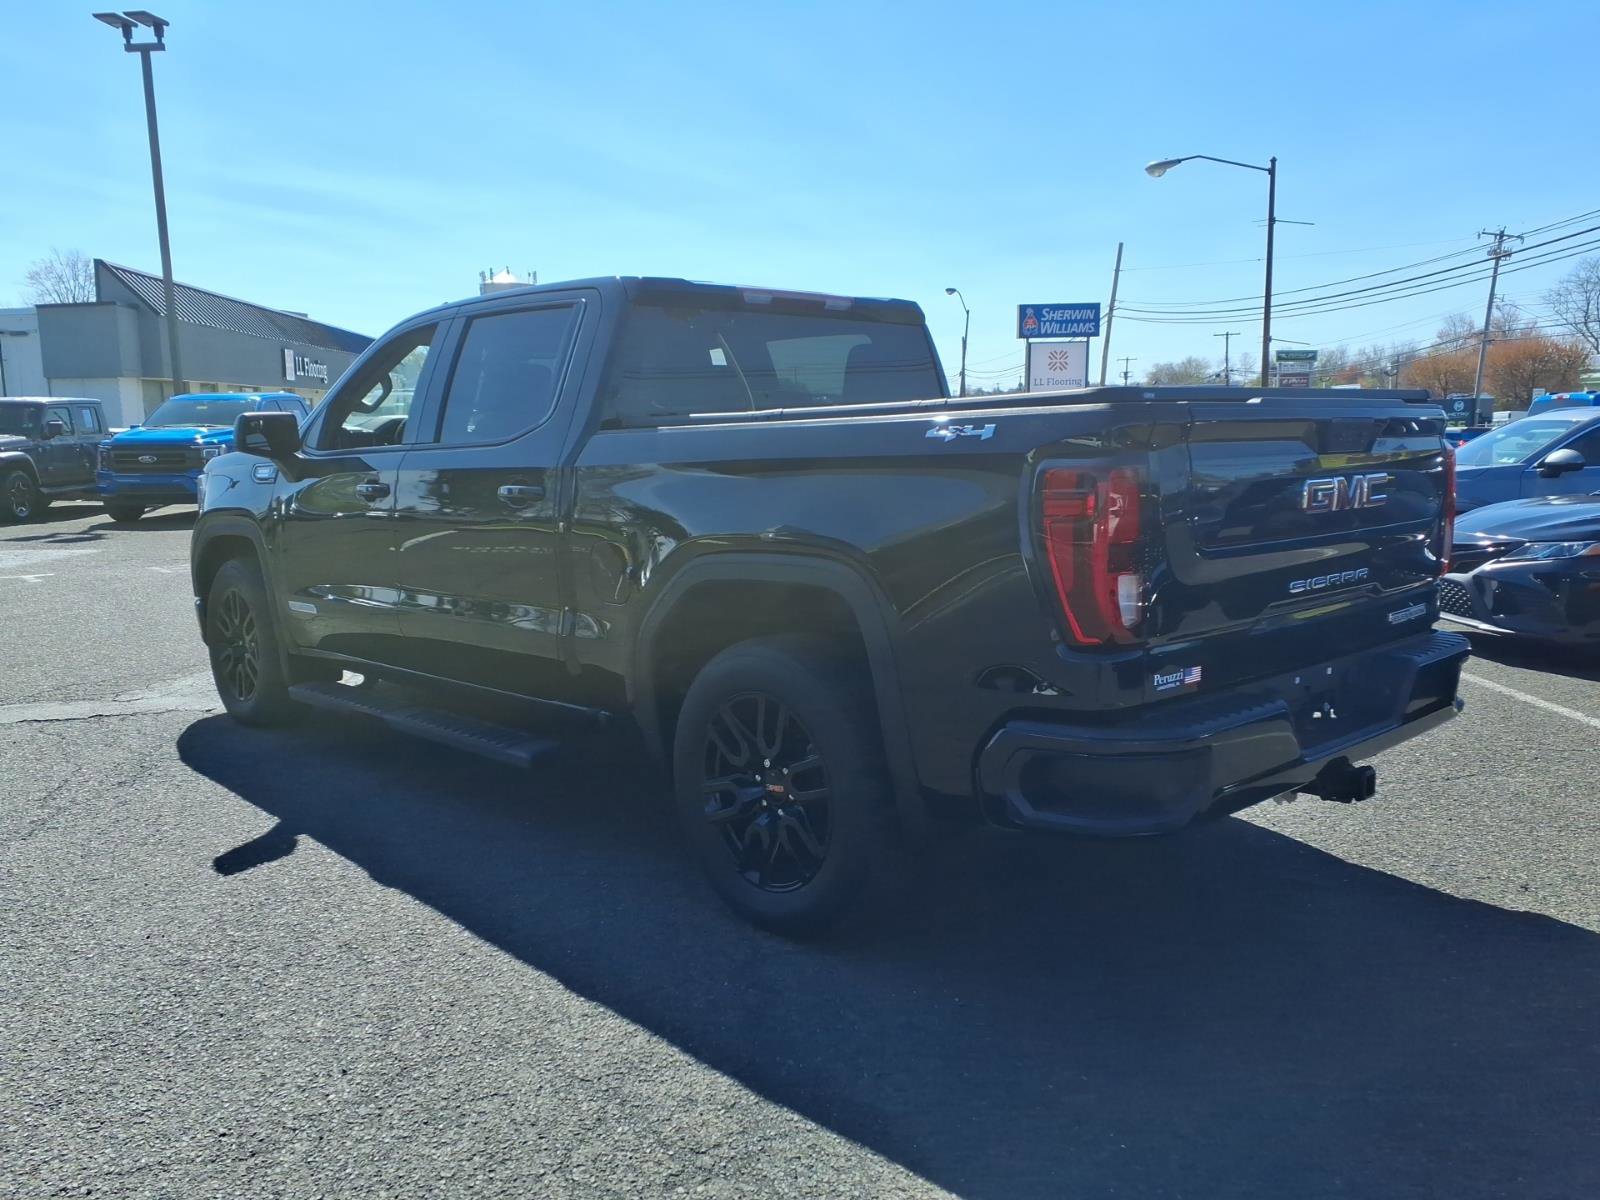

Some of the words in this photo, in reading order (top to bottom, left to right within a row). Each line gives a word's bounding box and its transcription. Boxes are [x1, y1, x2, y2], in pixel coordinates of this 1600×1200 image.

[1041, 308, 1095, 321] SHERWIN
[1040, 321, 1095, 334] WILLIAMS
[295, 356, 304, 376] LL
[304, 357, 328, 384] Flooring
[1033, 378, 1045, 387] LL
[1046, 377, 1082, 388] Flooring
[1302, 472, 1388, 514] GMC
[1289, 567, 1369, 594] SIERRA
[1153, 668, 1184, 686] Peruzzi
